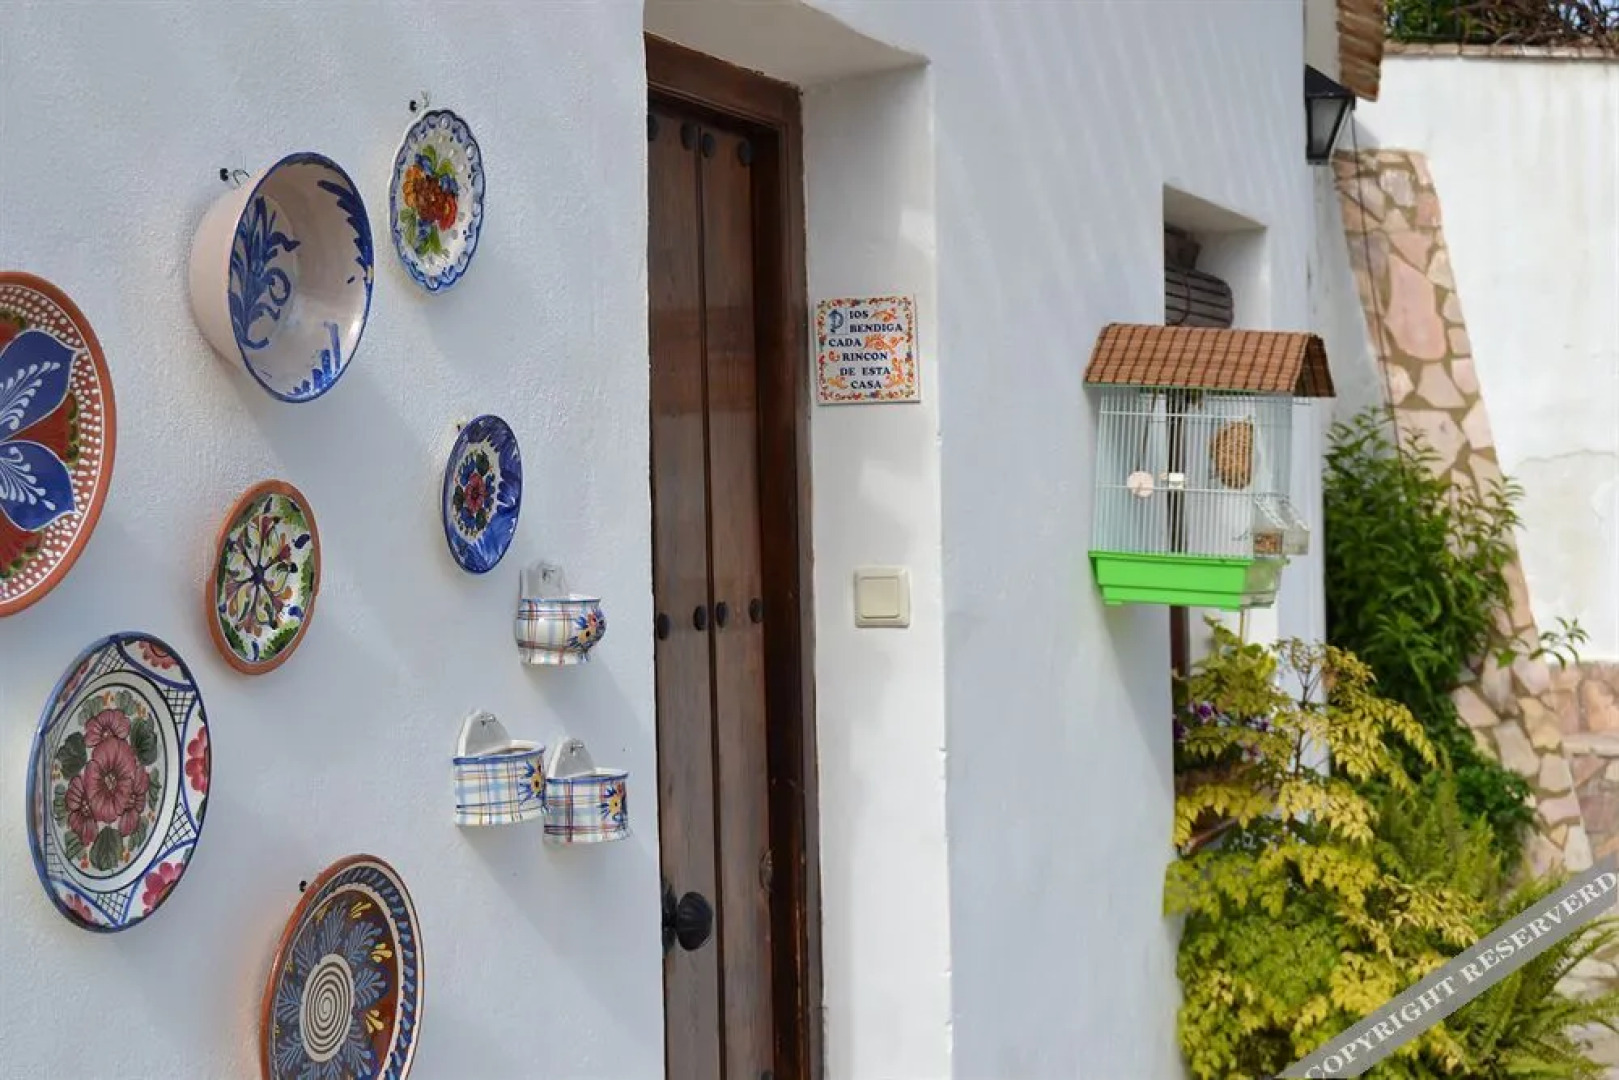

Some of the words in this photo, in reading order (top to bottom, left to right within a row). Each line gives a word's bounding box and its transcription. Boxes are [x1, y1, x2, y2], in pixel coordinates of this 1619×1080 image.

[849, 323, 903, 333] BENDIGA
[828, 338, 862, 347] CADA
[842, 352, 888, 361] RINCON
[840, 367, 855, 376] DE
[862, 367, 891, 376] ESTA
[850, 380, 882, 389] CASA
